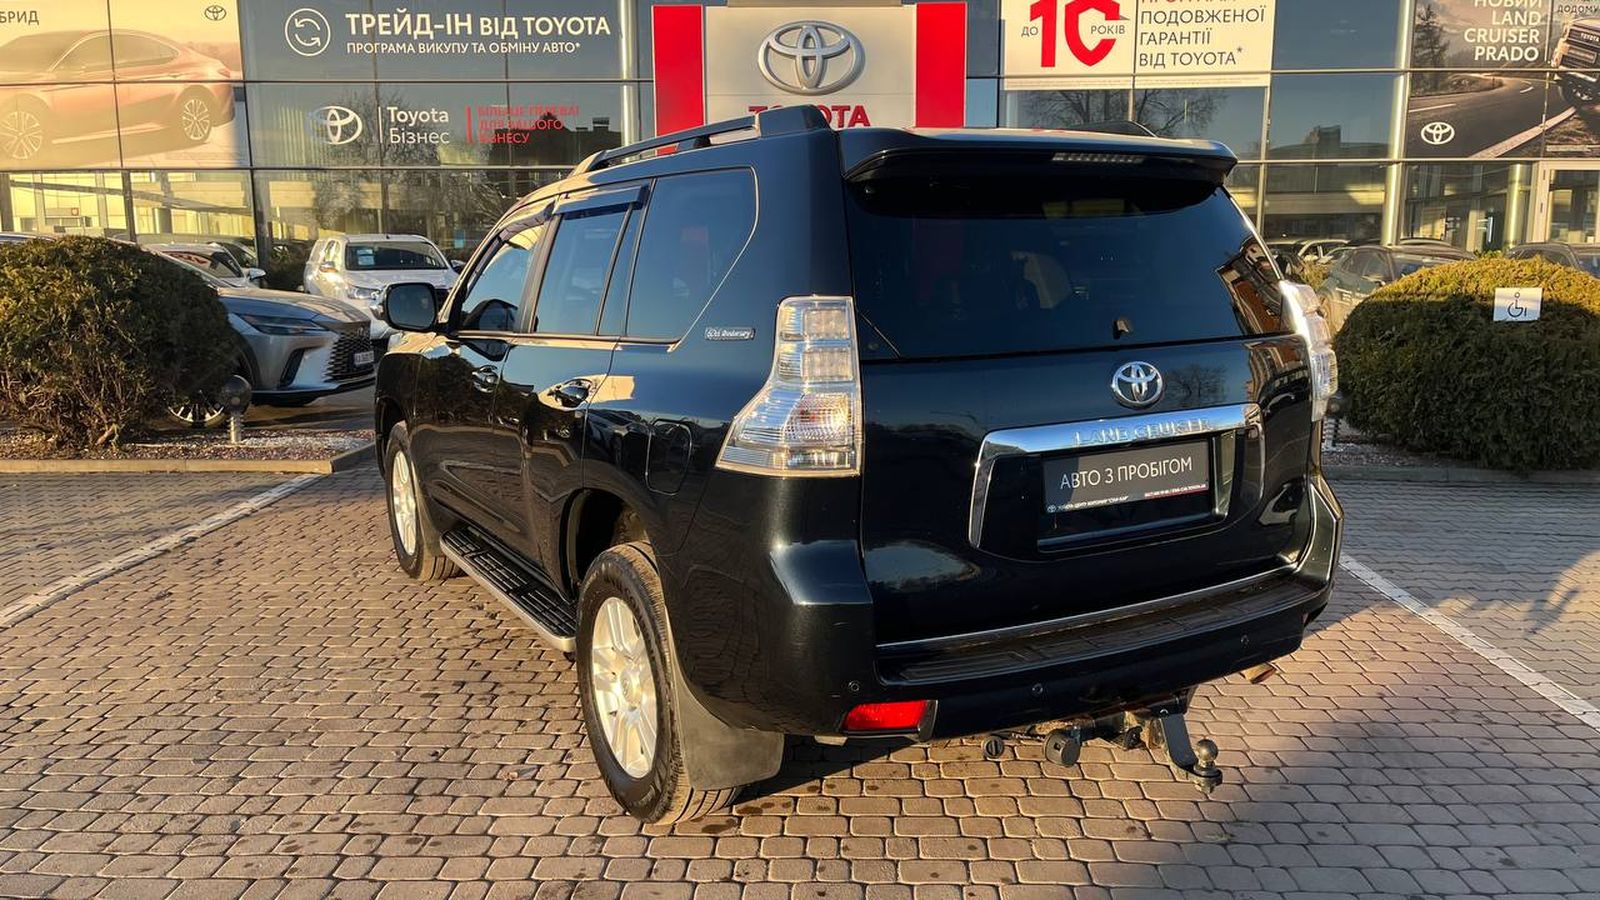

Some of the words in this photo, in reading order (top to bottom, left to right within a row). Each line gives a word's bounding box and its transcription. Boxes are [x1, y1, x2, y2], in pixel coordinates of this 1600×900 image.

[345, 8, 472, 40] ТРЕЙД-ІН
[479, 17, 519, 39] ВІД
[522, 16, 611, 36] TOYOTA
[1140, 5, 1266, 26] ПОДОВЖЕНОЇ
[1492, 11, 1541, 26] LAND
[1021, 26, 1039, 37] ДО
[1090, 24, 1126, 35] РОКІВ
[1140, 28, 1211, 45] ГАРАНТІЇ
[1464, 28, 1540, 43] CRUISER
[347, 42, 415, 54] ПРОГРАМА
[418, 42, 468, 54] ВИКУПУ
[471, 42, 486, 53] ТА
[489, 41, 540, 53] ОБМІНУ
[1474, 46, 1539, 61] PRADO
[1139, 52, 1165, 69] ВІД
[386, 106, 449, 127] Toyota
[389, 127, 449, 144] Бізнес
[1074, 427, 1127, 446] LAND
[1134, 418, 1213, 439] CRUISER
[1060, 469, 1100, 489] АВТО
[1118, 456, 1192, 481] ПРОБІГОМ
